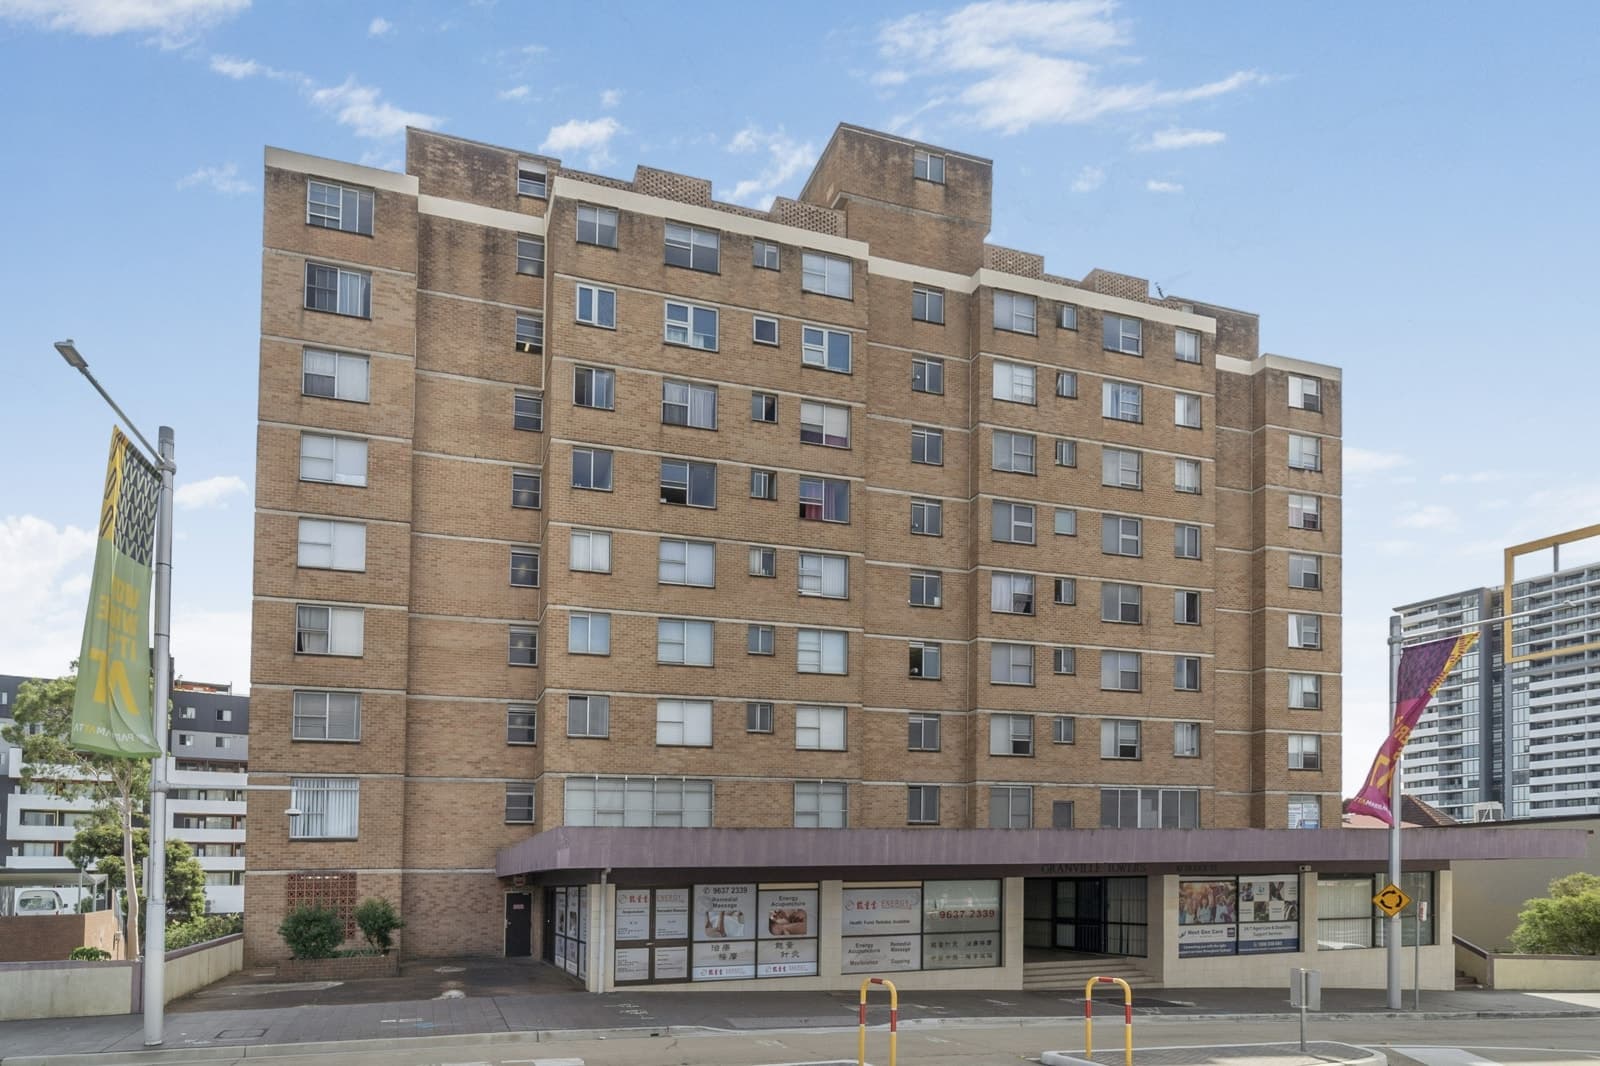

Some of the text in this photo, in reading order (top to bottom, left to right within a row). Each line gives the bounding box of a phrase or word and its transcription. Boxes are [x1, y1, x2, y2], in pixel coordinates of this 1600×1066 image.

[1041, 862, 1147, 873] GRANVILLE TOWERS
[712, 886, 748, 895] 9637 2339
[939, 909, 995, 919] 9637 2339
